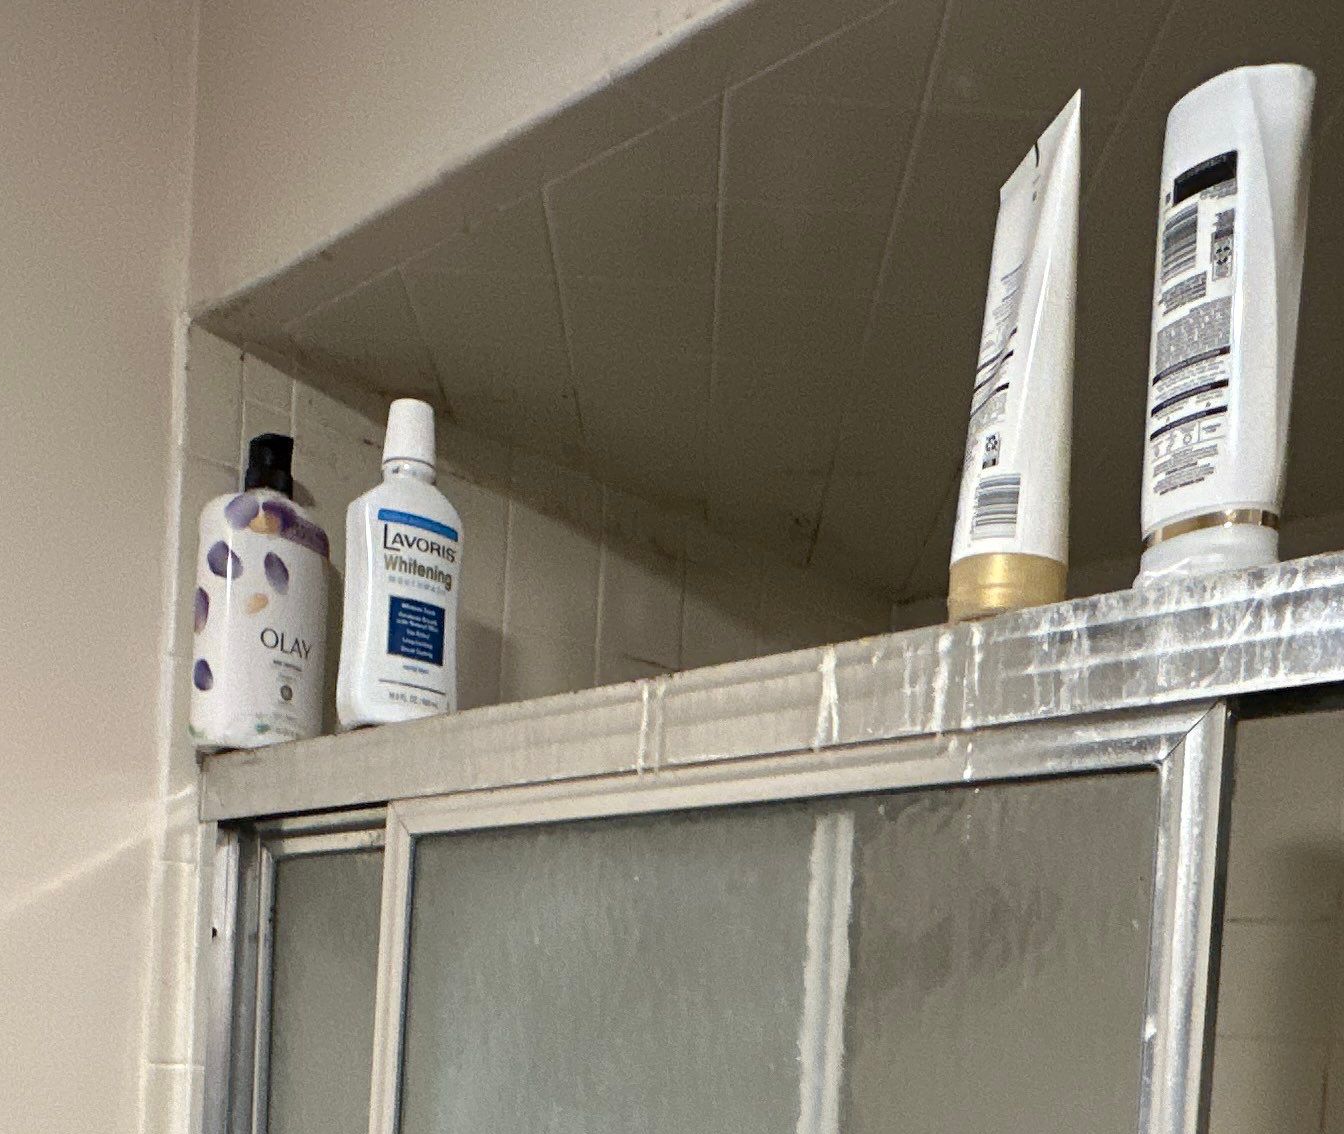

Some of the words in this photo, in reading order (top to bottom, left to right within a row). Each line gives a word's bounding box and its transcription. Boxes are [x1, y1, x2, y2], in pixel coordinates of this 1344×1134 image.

[383, 523, 456, 563] LAVORIS
[384, 553, 452, 592] Whitening
[260, 627, 312, 659] OLAY
